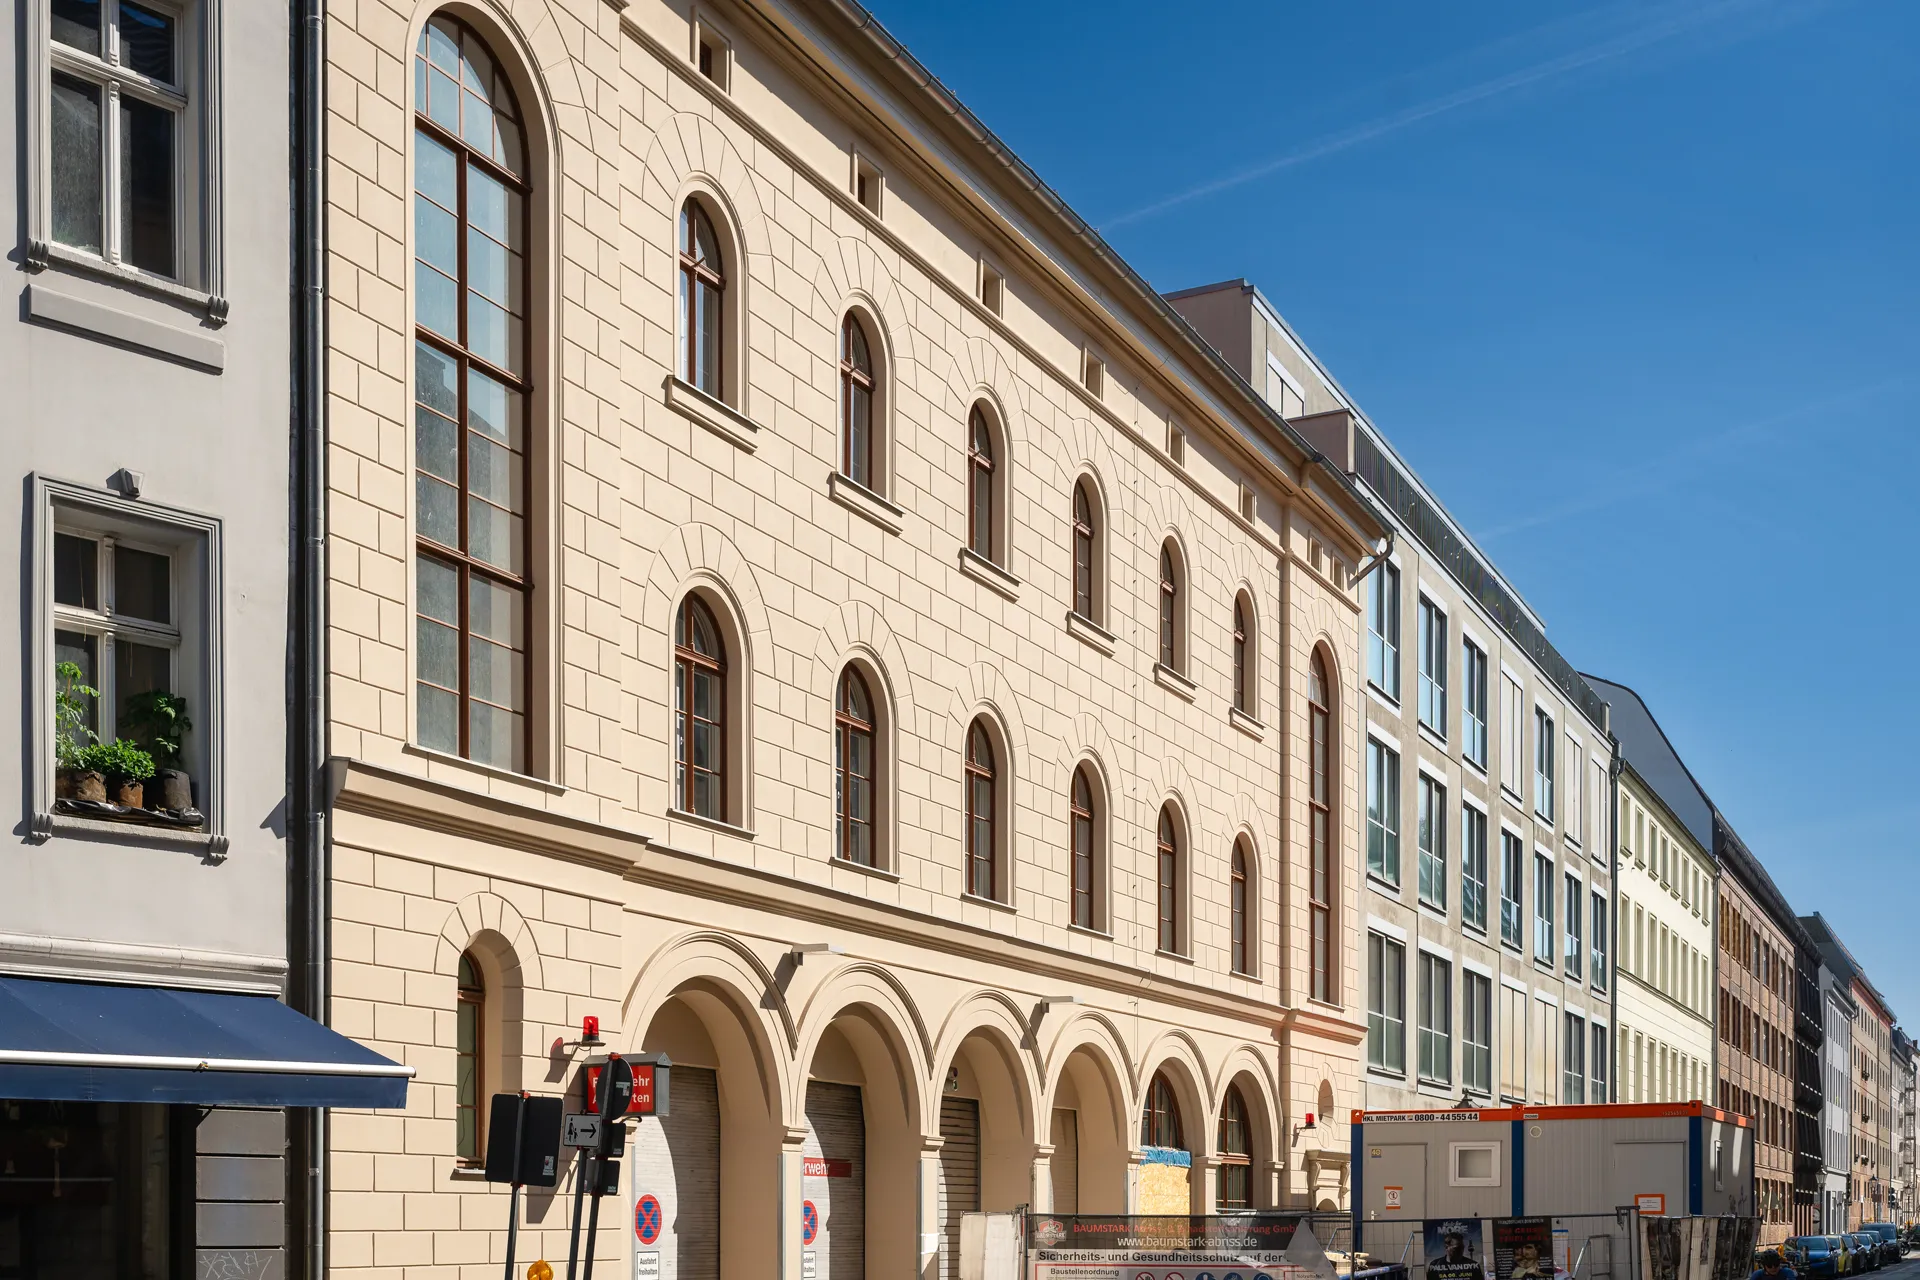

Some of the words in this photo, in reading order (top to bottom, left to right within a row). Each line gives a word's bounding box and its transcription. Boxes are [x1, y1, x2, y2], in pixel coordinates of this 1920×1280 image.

[804, 1160, 830, 1175] rwehr
[1074, 1224, 1130, 1233] BAUMSTARK
[1273, 1224, 1298, 1233] Gmb
[1437, 1225, 1468, 1234] MORE
[1117, 1237, 1257, 1247] www.baumstark-abriss.de
[1039, 1252, 1104, 1261] Sicherheits-
[1108, 1252, 1129, 1261] und
[1132, 1252, 1240, 1262] Gesundheitsschutz
[1264, 1253, 1283, 1262] der
[1447, 1263, 1463, 1271] VAN
[1463, 1262, 1479, 1270] DYK
[1050, 1268, 1120, 1277] Baustellenordnung
